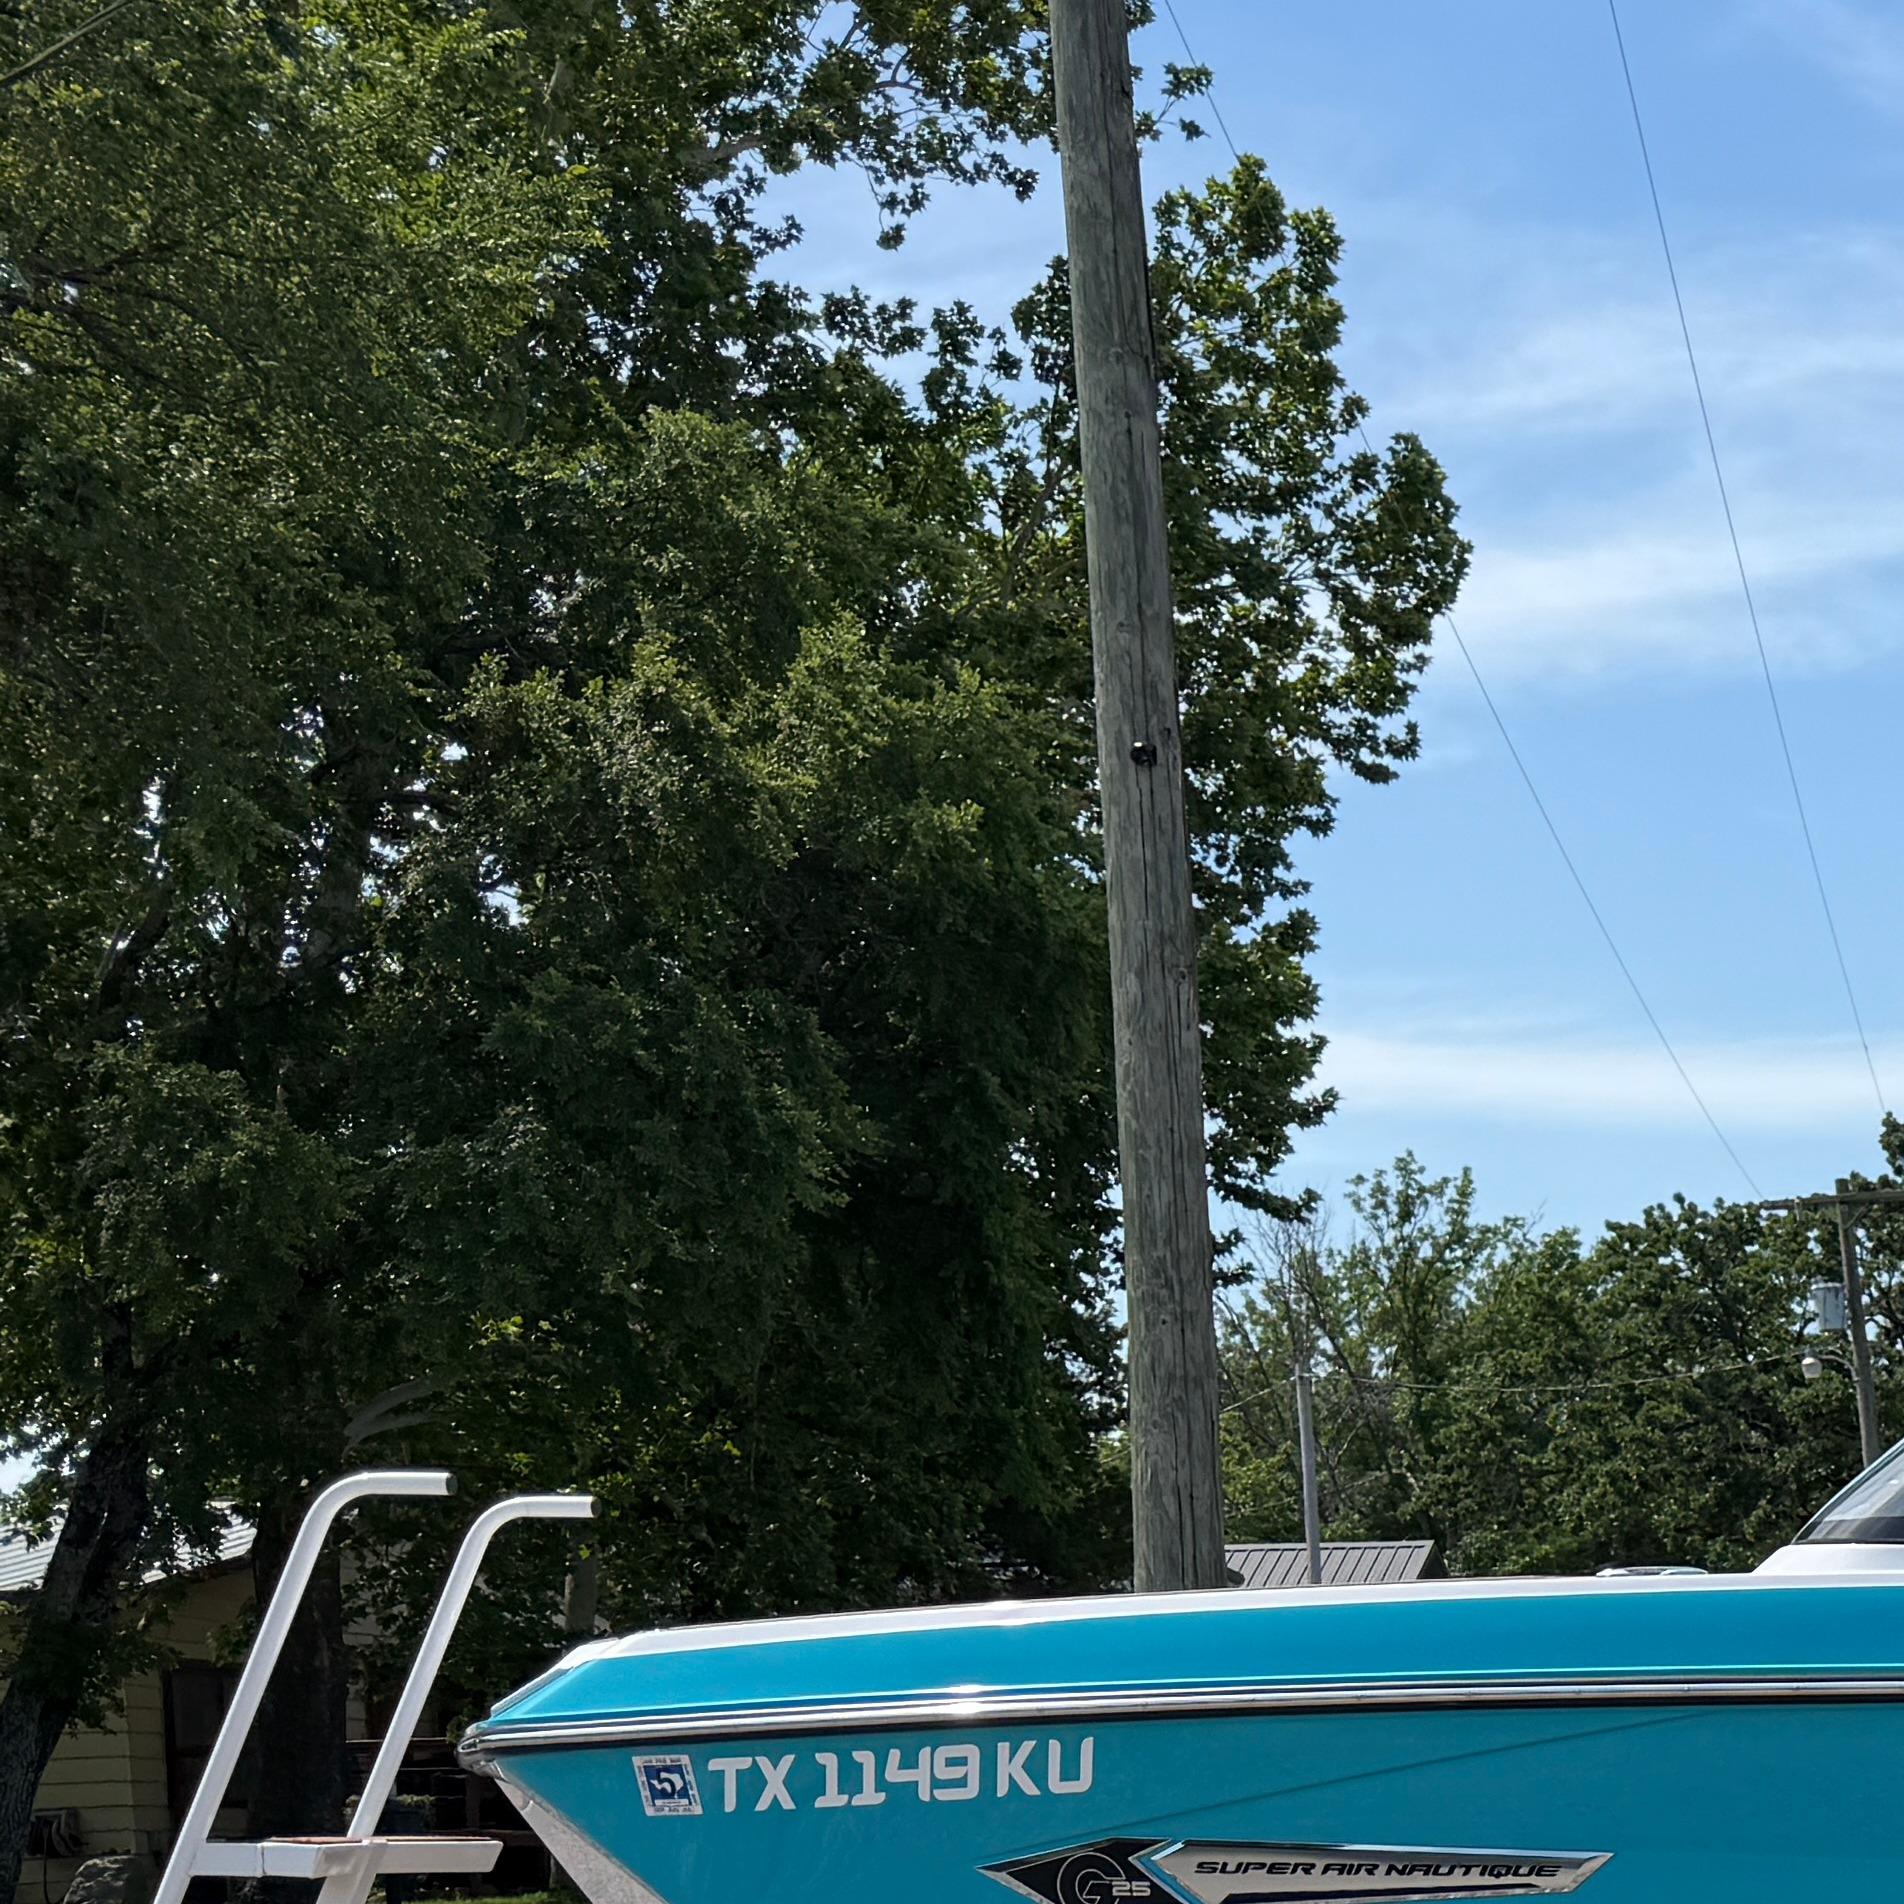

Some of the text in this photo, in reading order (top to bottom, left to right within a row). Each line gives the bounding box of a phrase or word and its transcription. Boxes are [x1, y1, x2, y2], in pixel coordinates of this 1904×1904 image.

[707, 1754, 797, 1813] TX
[814, 1744, 981, 1808] 1149
[996, 1737, 1094, 1798] KU
[1194, 1861, 1563, 1878] SUPER AIR NAUTIQUE
